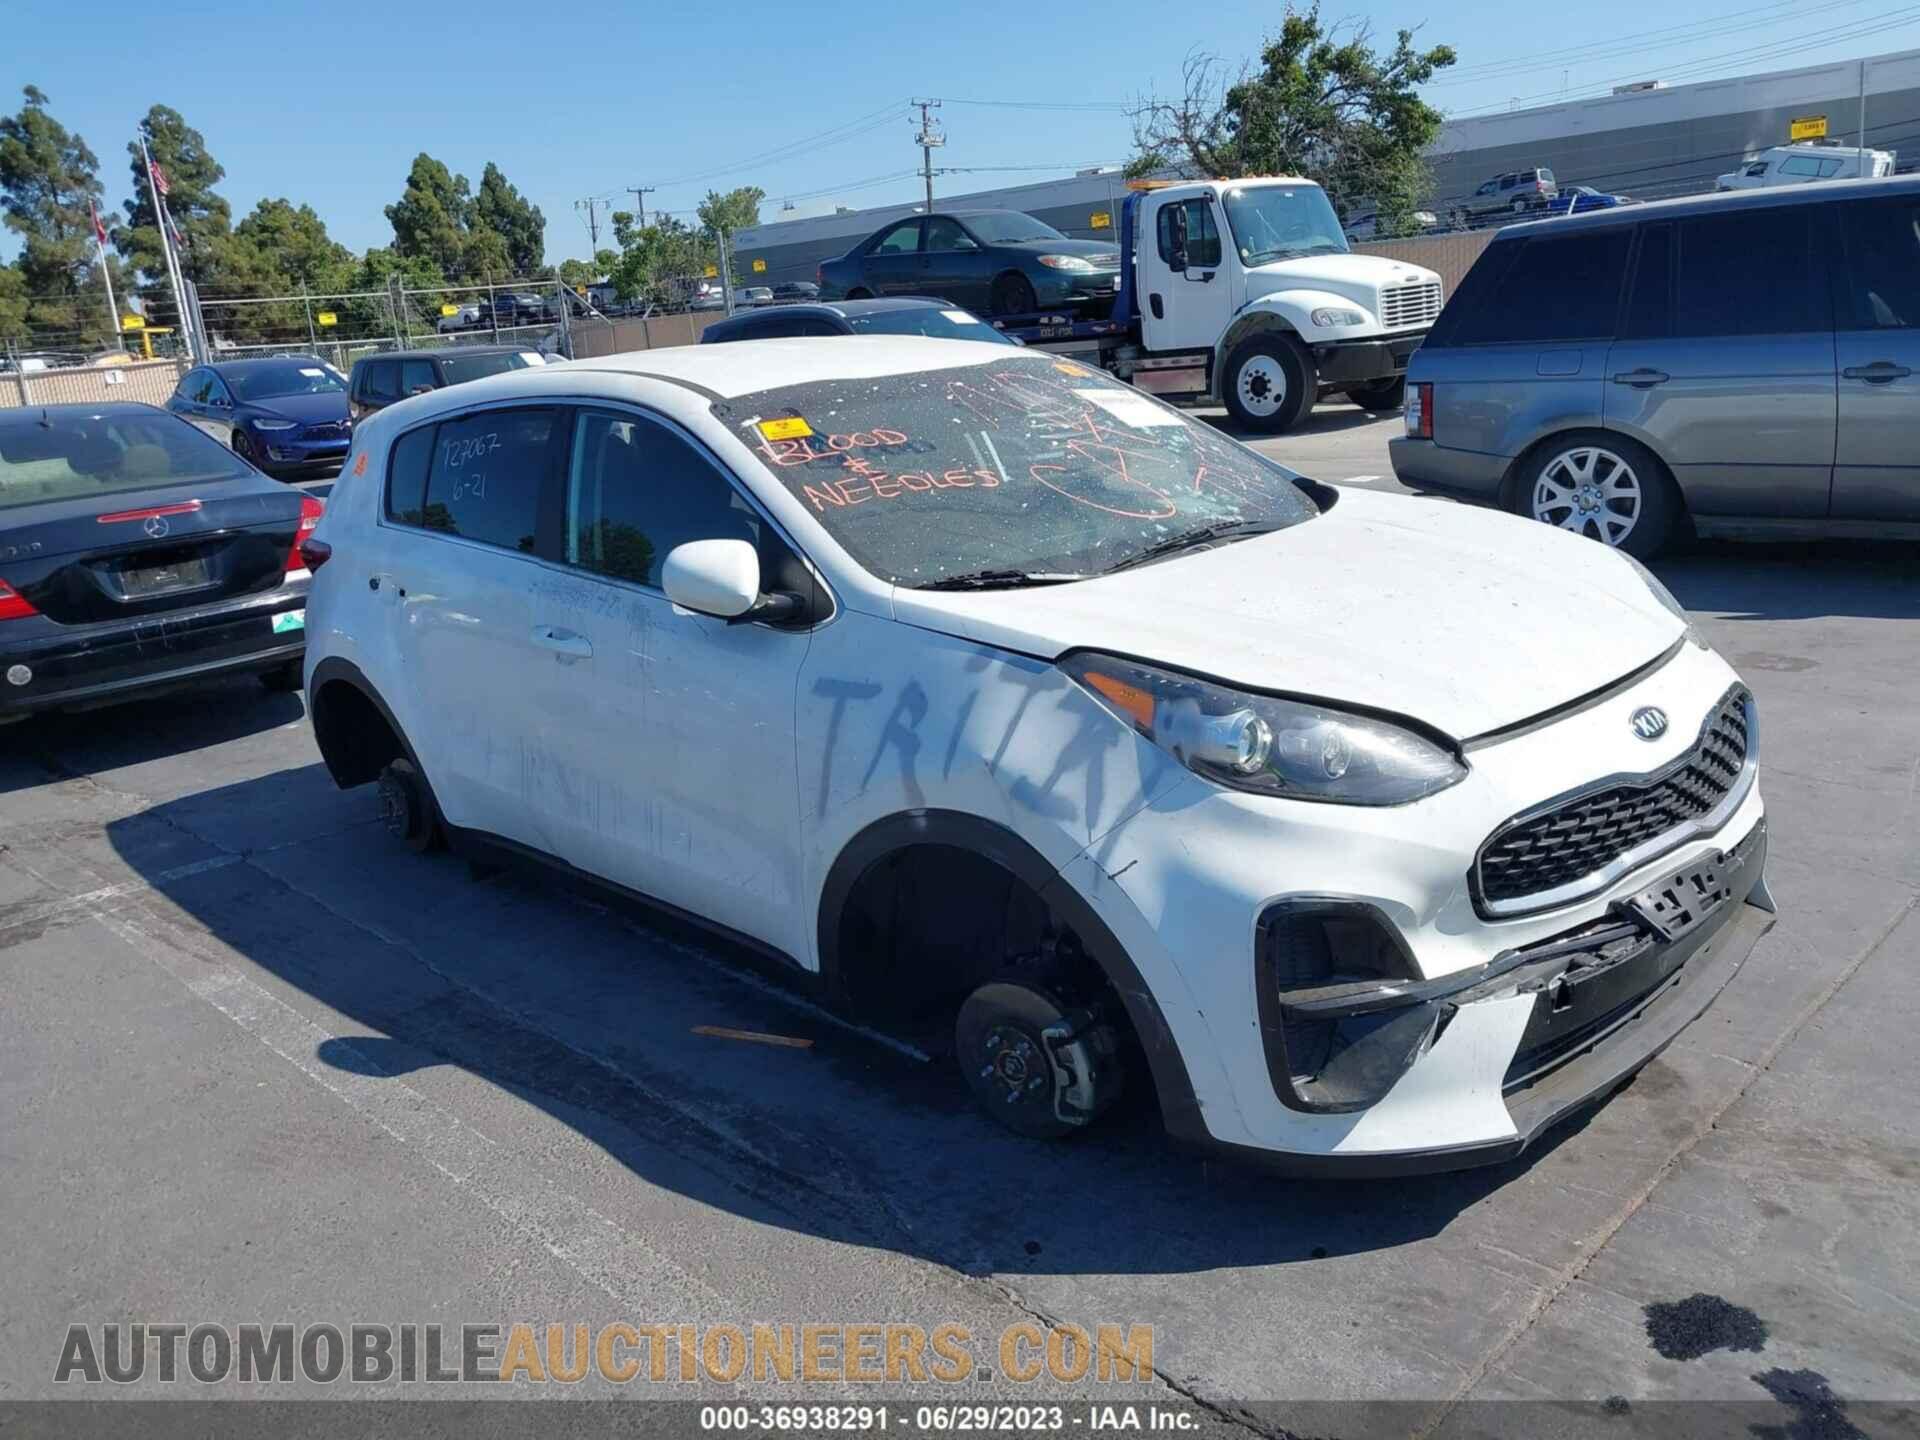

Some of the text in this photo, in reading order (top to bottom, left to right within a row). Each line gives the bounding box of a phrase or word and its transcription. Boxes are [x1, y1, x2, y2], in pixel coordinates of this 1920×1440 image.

[756, 428, 908, 467] BLOOD
[802, 468, 1000, 512] NEEDLES
[1635, 708, 1665, 737] KIA
